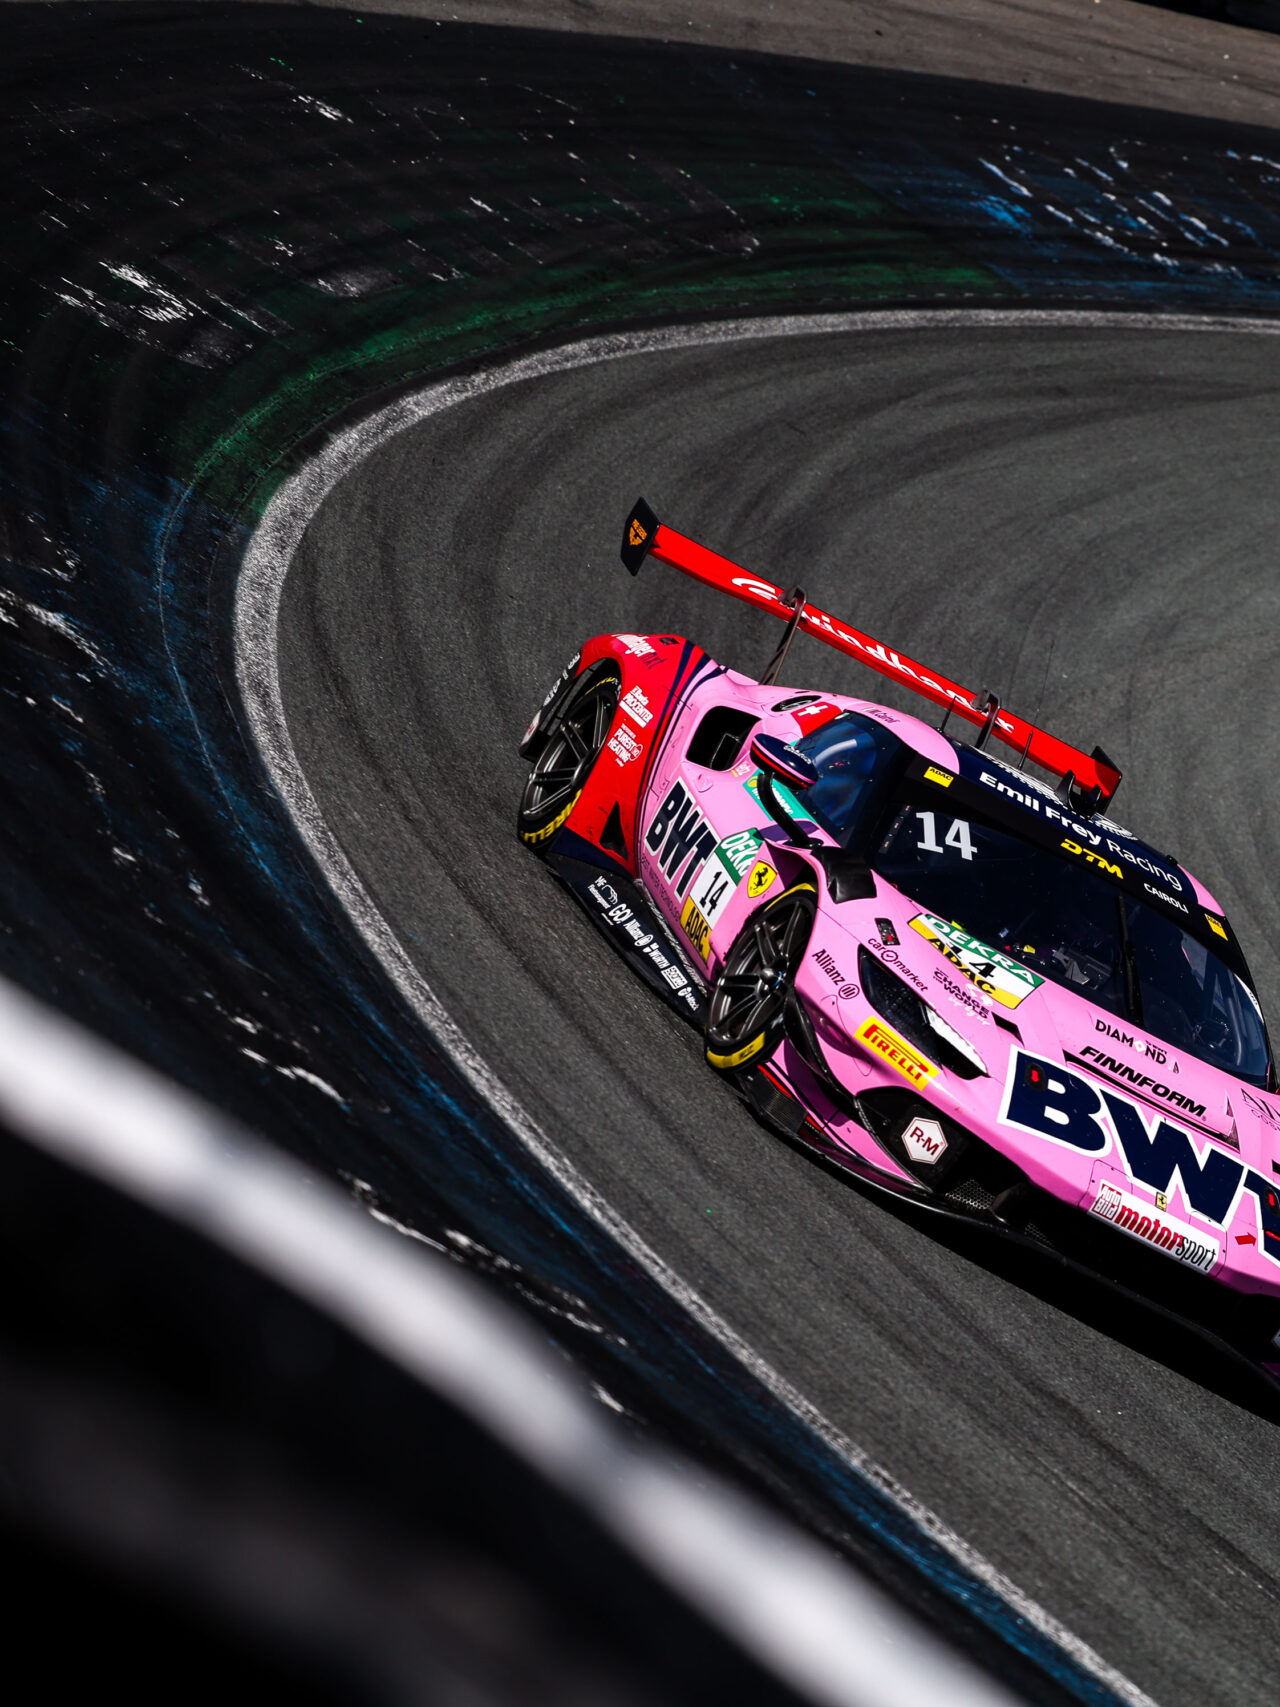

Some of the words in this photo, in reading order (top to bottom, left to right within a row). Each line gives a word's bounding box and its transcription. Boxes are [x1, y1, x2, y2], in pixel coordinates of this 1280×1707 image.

[929, 767, 953, 782] ADAC
[644, 776, 721, 904] BWT
[915, 811, 978, 861] 14
[979, 771, 1040, 811] Emil
[1045, 805, 1102, 845] Frey
[1107, 838, 1183, 891] Racing
[721, 831, 759, 877] DEKR
[1060, 838, 1124, 879] DTM
[699, 871, 728, 917] 14
[1144, 883, 1189, 914] CAIROLI
[684, 906, 708, 954] ADAC
[929, 916, 1037, 985] DEKRA
[812, 949, 845, 985] Allianz
[893, 960, 928, 992] market
[928, 938, 996, 994] ADAC
[934, 971, 989, 1015] CHANGE
[944, 983, 987, 1019] WORLD
[863, 1024, 929, 1080] PIRELLI
[1079, 1046, 1207, 1117] FINNFORM
[909, 1126, 940, 1156] R-M
[1094, 1199, 1119, 1220] Bild
[1100, 1184, 1122, 1205] Auto
